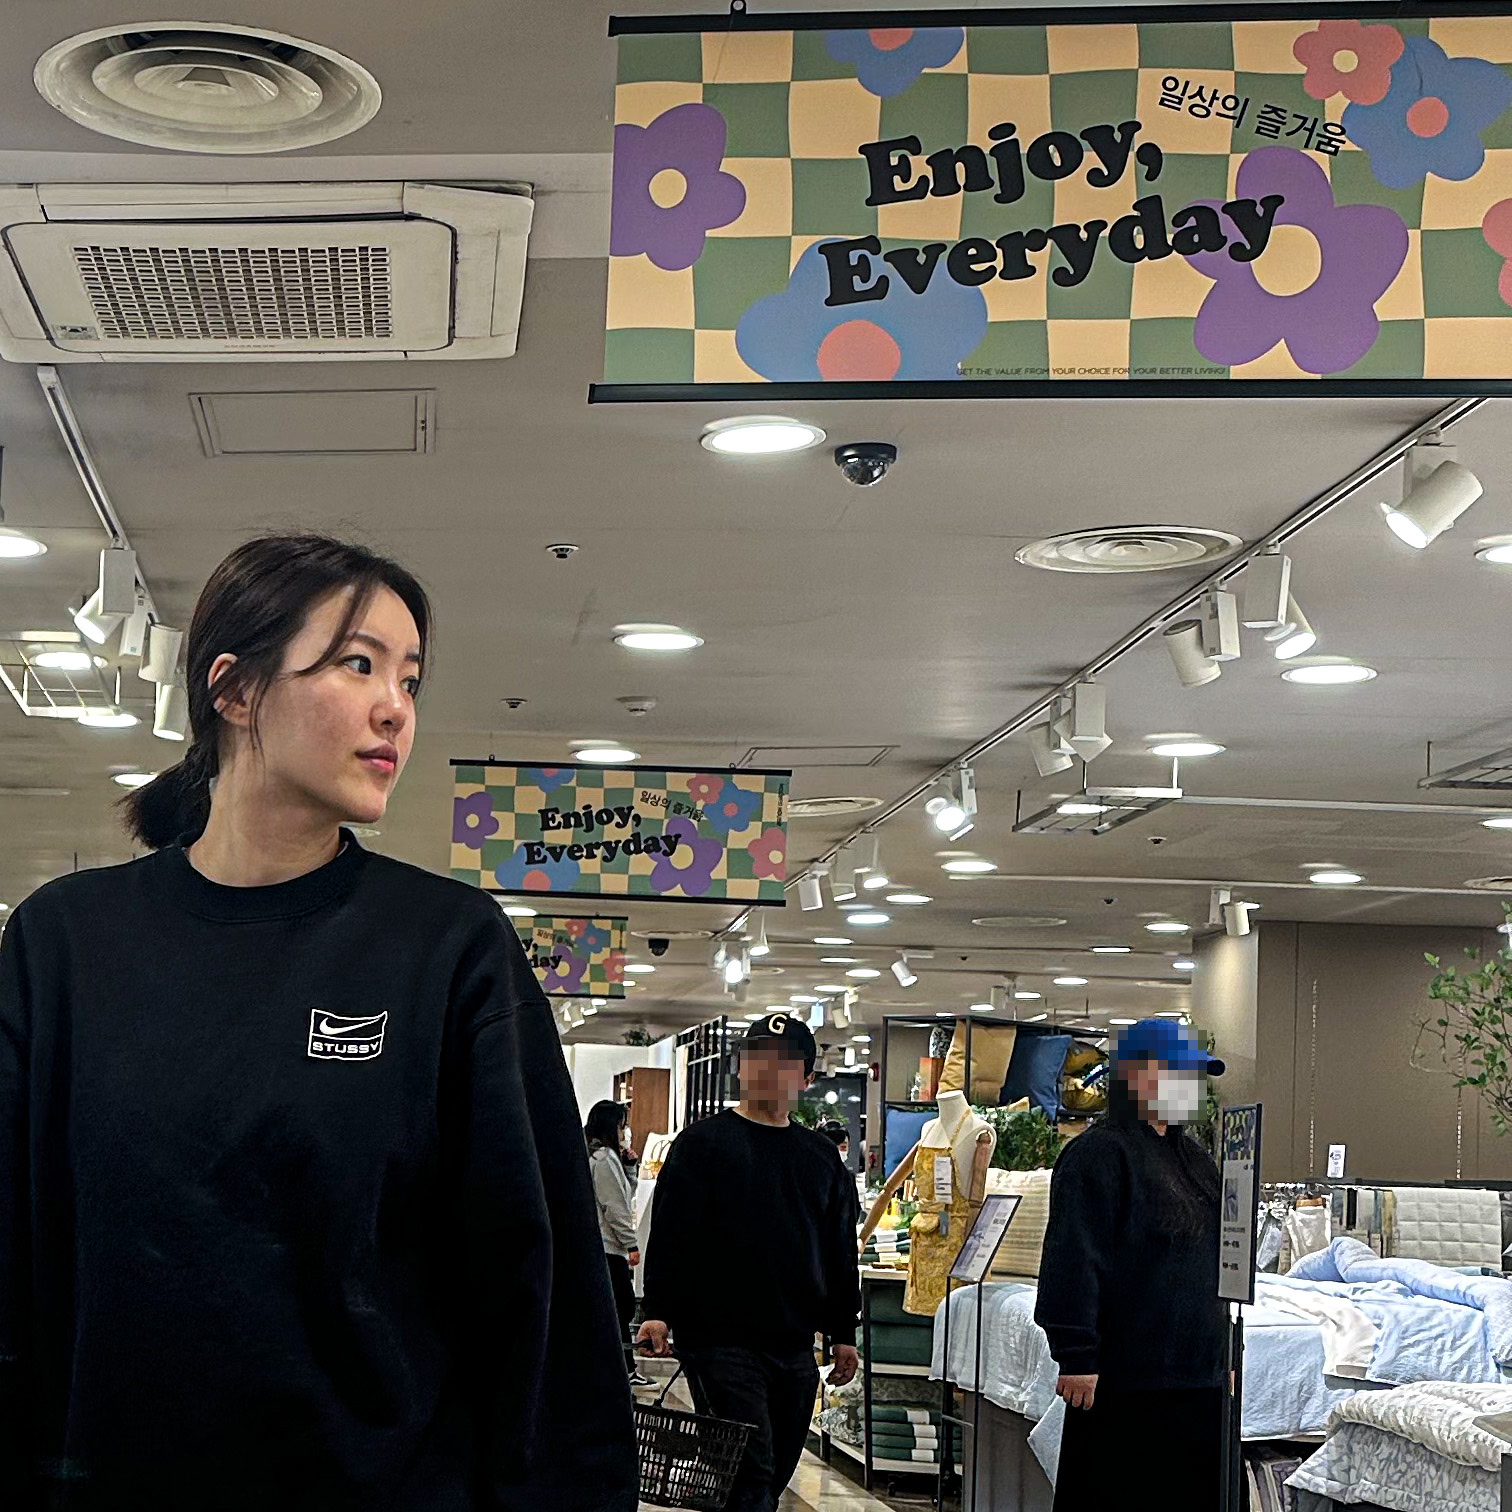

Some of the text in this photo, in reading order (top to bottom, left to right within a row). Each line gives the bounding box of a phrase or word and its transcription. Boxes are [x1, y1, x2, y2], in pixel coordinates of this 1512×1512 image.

[1159, 76, 1347, 157] 일상의 즐거움
[858, 121, 1164, 206] Enjoy,
[818, 194, 1285, 306] Everyday
[975, 367, 992, 376] THE
[994, 367, 1022, 376] VALUE
[1024, 367, 1049, 376] FROM
[1052, 367, 1076, 376] YOUR
[1078, 367, 1111, 376] CHOICE
[1133, 367, 1157, 376] YOUR
[1159, 367, 1193, 376] BETTER
[640, 790, 672, 810] 일상의
[538, 804, 642, 833] Enjoy,
[523, 832, 682, 866] Everyday
[768, 1013, 787, 1035] G
[312, 1041, 379, 1054] STUSSY
